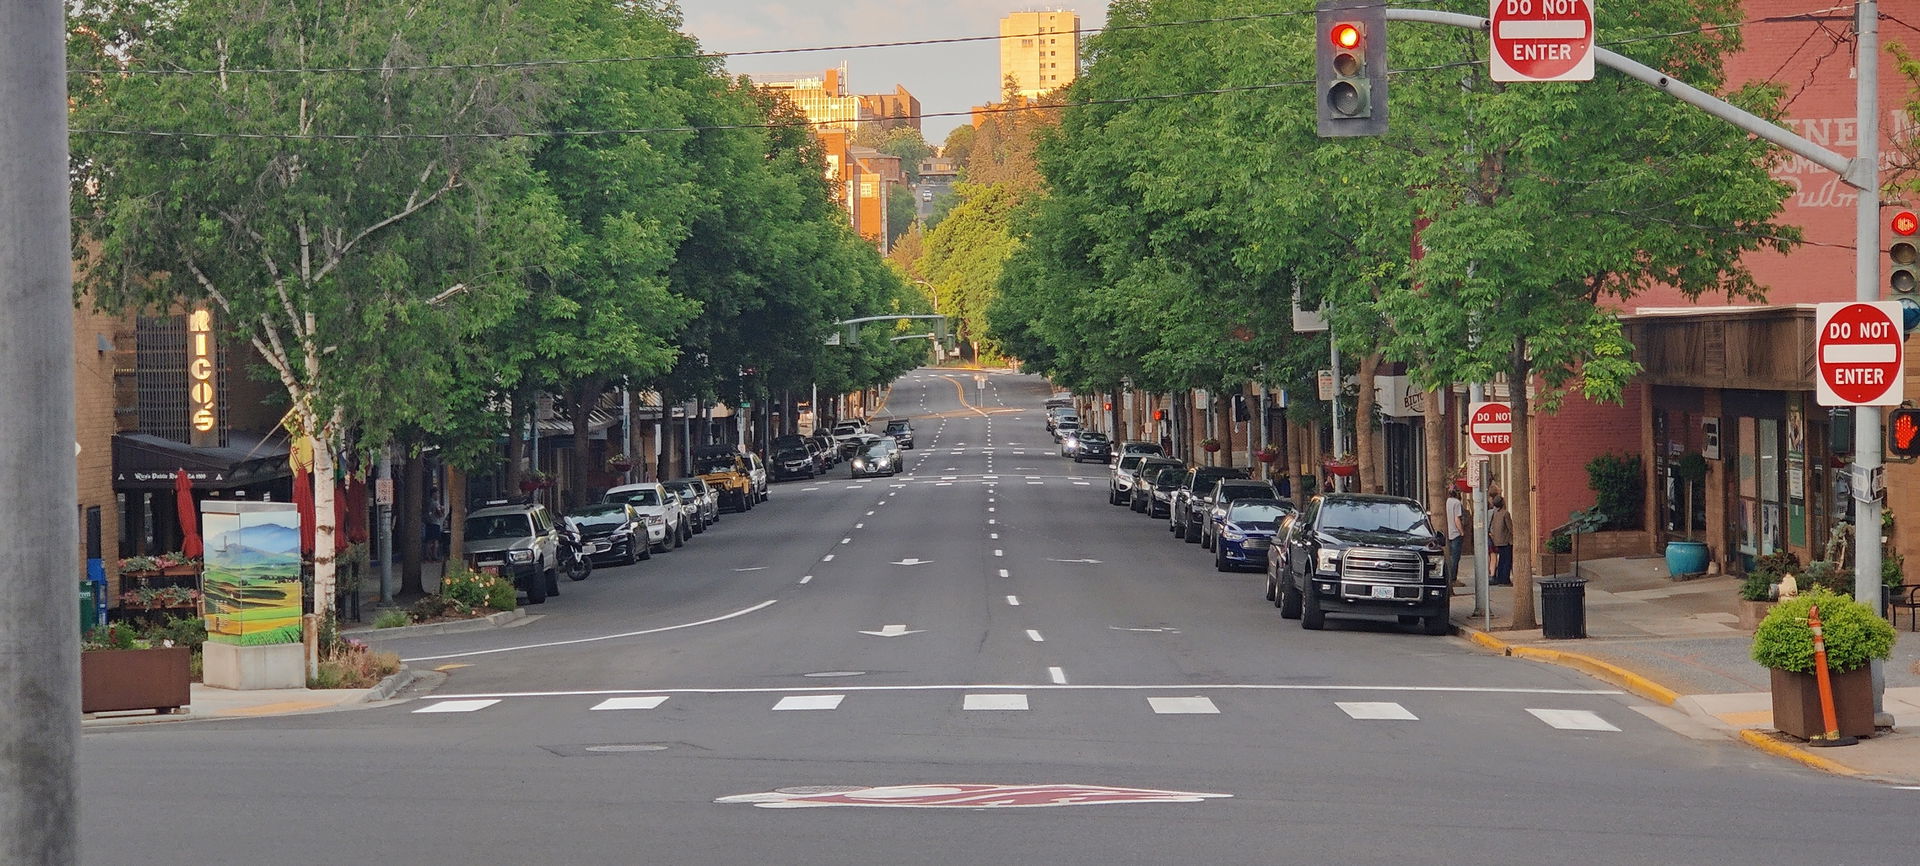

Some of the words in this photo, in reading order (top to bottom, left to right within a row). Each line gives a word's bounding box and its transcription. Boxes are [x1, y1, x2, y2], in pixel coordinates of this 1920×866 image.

[1507, 0, 1532, 15] DO
[1542, 0, 1578, 14] NOT
[1513, 44, 1571, 60] ENTER
[1829, 322, 1851, 339] DO
[1860, 321, 1890, 338] NOT
[190, 310, 214, 431] RICO'S
[1835, 368, 1884, 385] ENTER
[1404, 391, 1424, 408] BICYC
[1477, 412, 1490, 422] DO
[1481, 434, 1510, 444] ENTER
